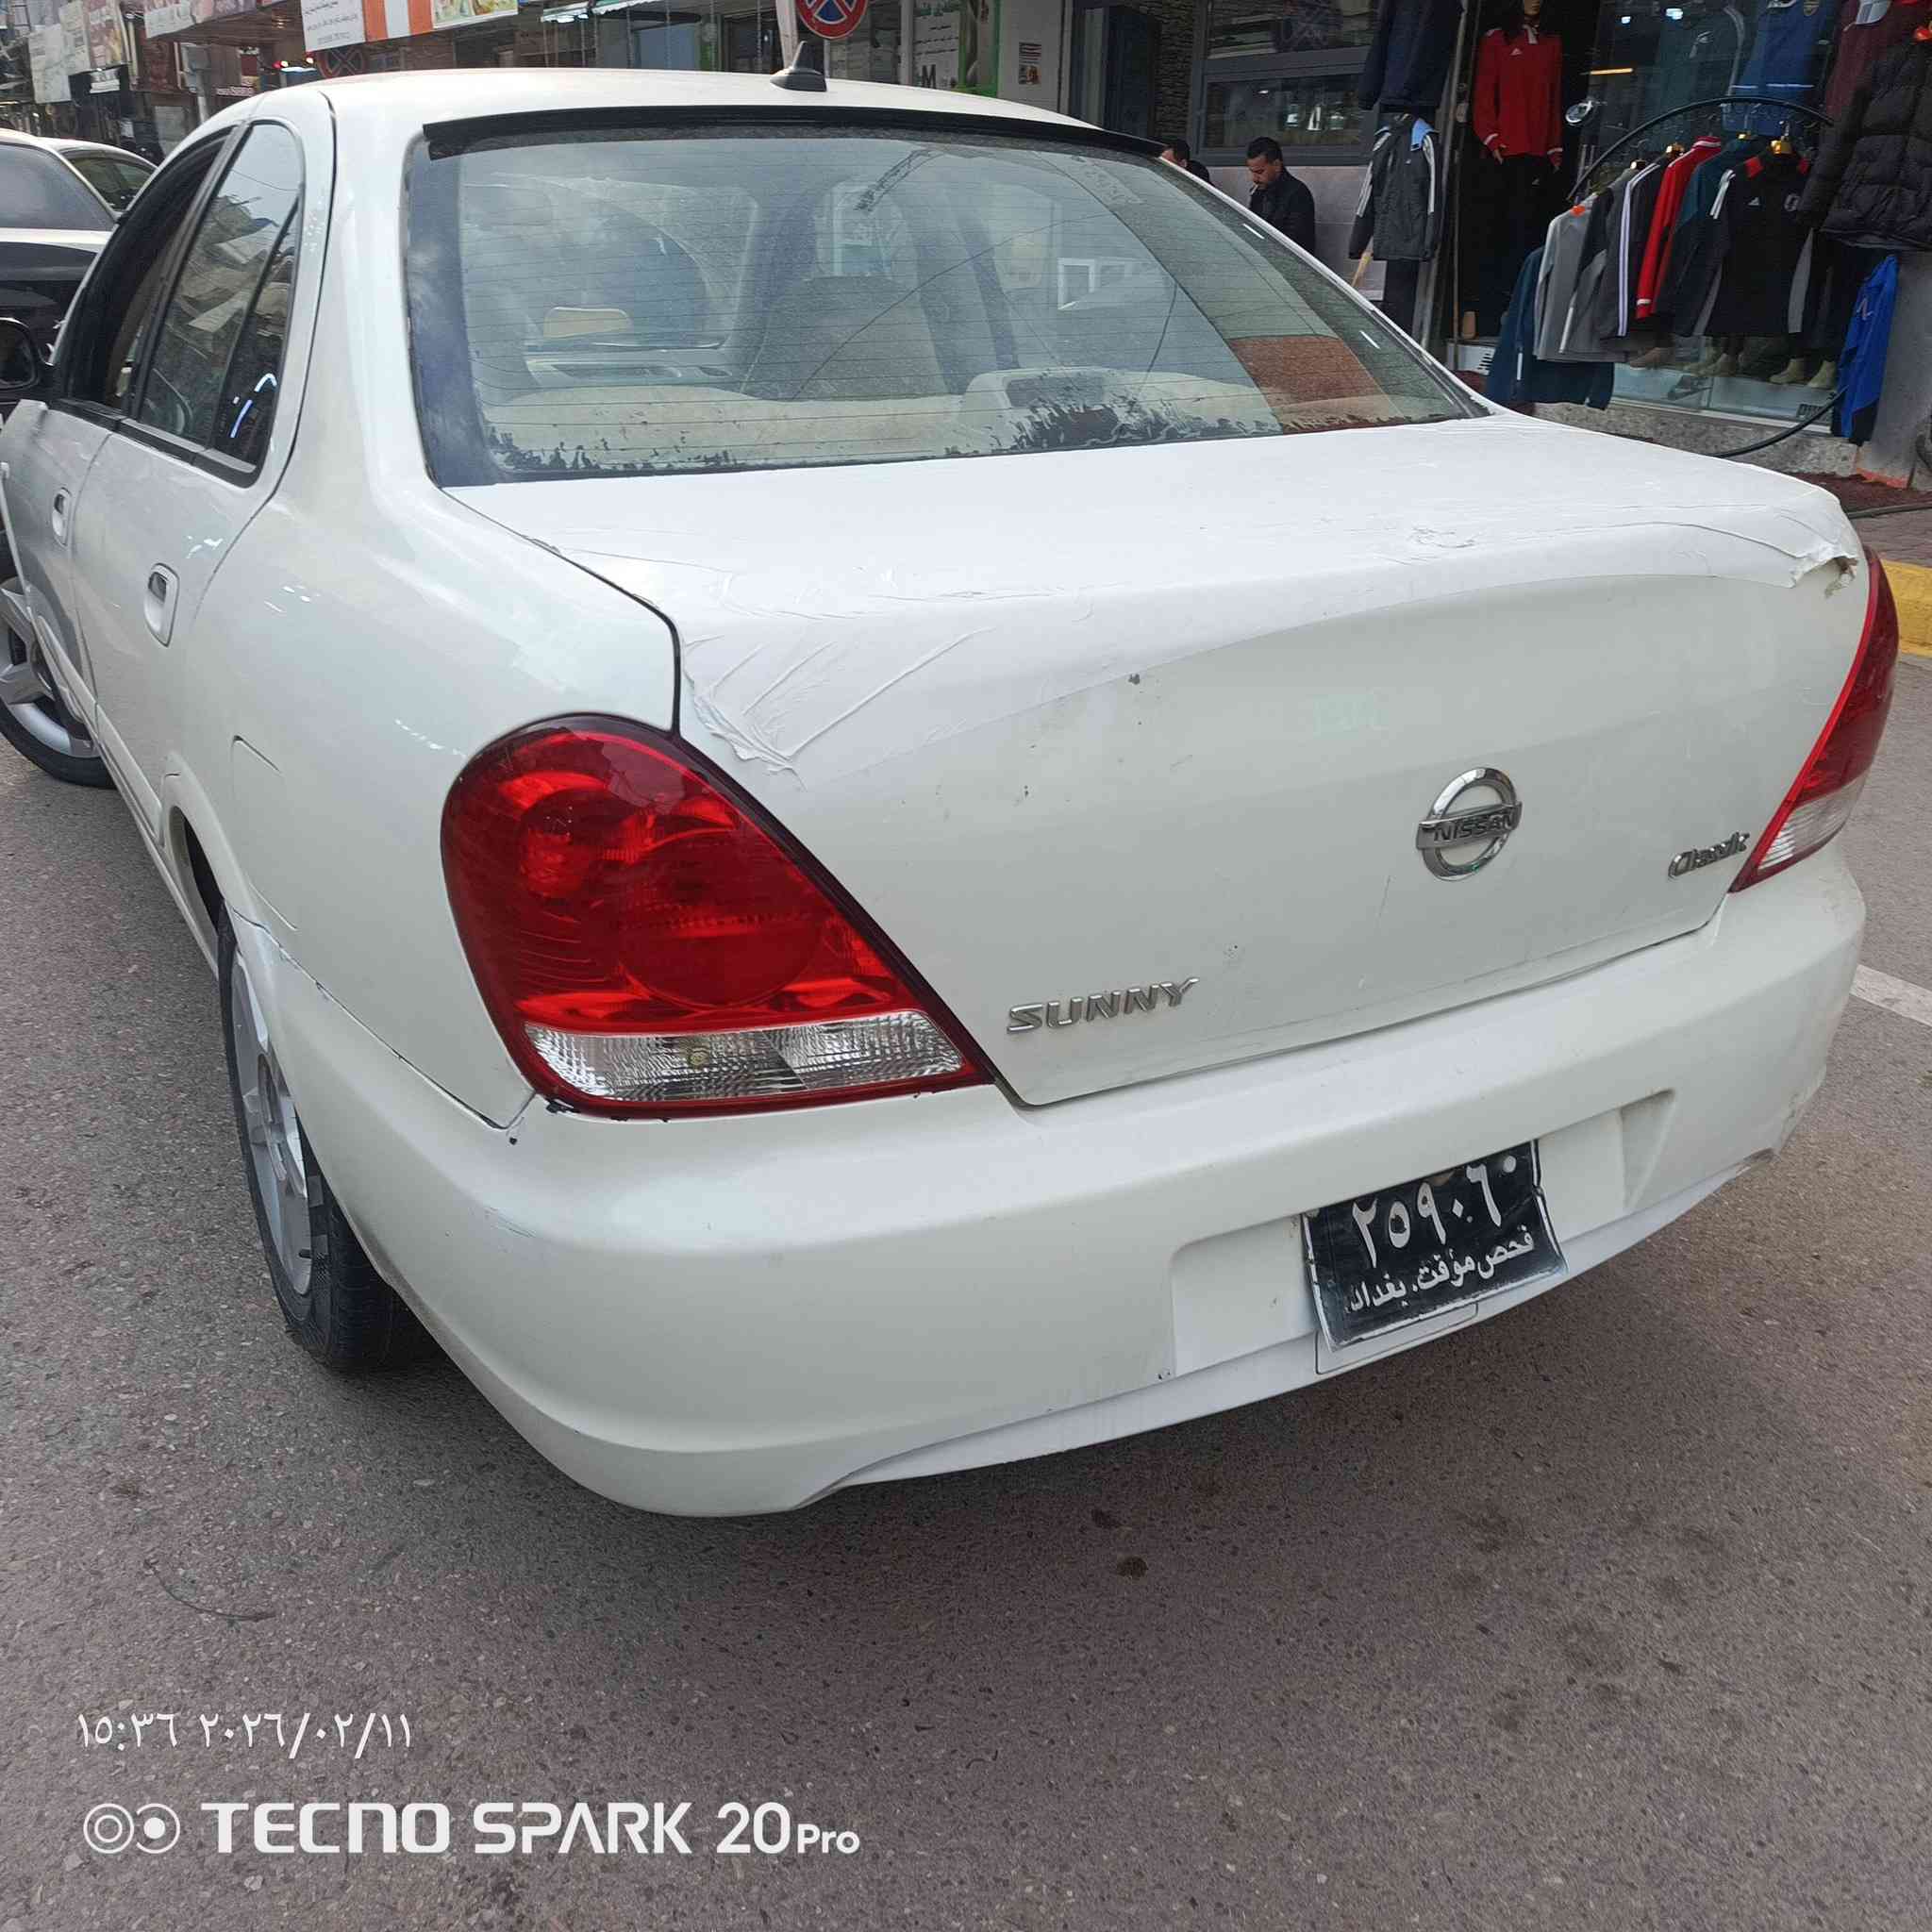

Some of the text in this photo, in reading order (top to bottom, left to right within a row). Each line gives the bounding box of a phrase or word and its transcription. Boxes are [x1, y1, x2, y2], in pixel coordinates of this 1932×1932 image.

[1434, 813, 1515, 842] NISSAN
[1007, 977, 1200, 1035] SUNNY
[1477, 1224, 1534, 1279] فحص
